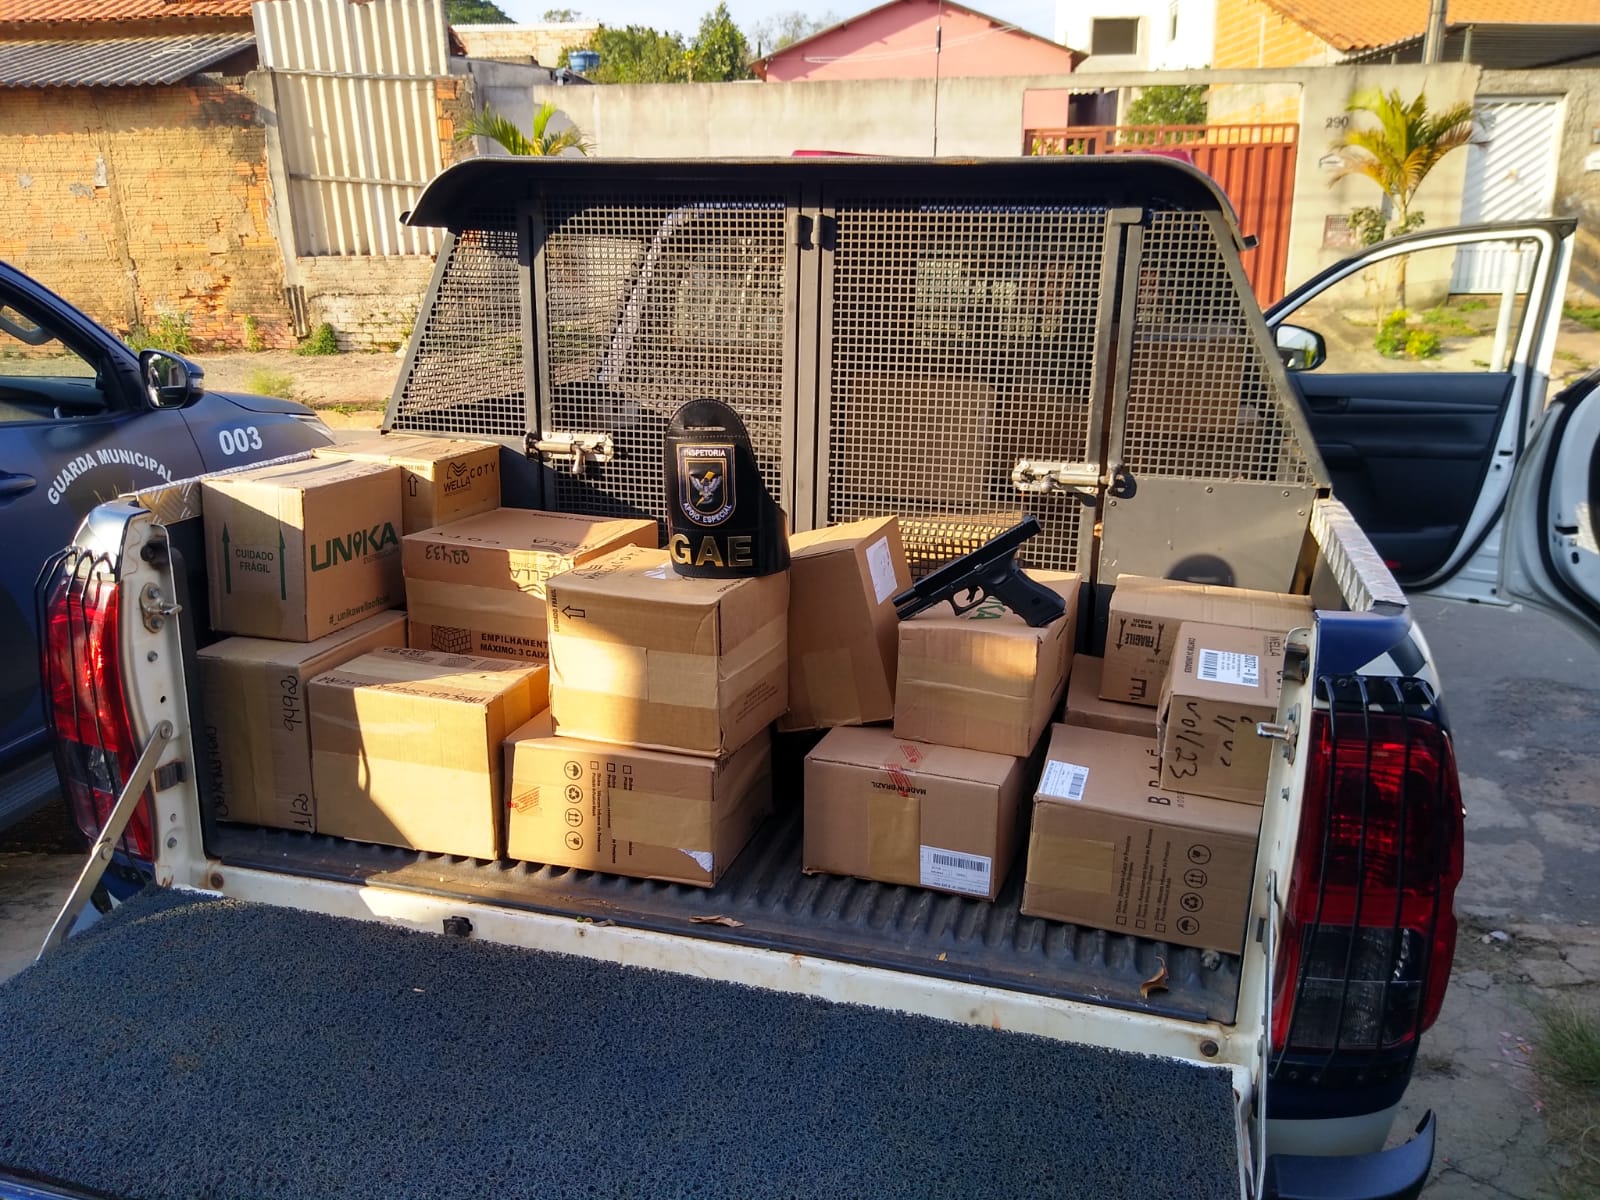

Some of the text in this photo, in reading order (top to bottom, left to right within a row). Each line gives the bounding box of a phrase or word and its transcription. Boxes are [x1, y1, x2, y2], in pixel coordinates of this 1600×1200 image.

[1325, 116, 1349, 129] 290
[218, 426, 263, 456] 003
[683, 449, 726, 458] INSPETORIA
[47, 448, 173, 505] GUARDA MUNICIPAL
[469, 461, 497, 479] COTY
[443, 477, 471, 493] WELLA
[683, 502, 733, 524] APOIO ESPECIAL
[235, 548, 274, 561] CUIDADO
[669, 533, 754, 568] GAE
[509, 568, 556, 582] ELLA
[481, 632, 549, 649] EMPILHAMENT
[1124, 632, 1155, 649] FRAGILE
[1268, 636, 1282, 657] WELLA
[518, 648, 524, 656] 3
[525, 649, 549, 660] CAIX
[871, 781, 896, 791] BRAZIL
[905, 786, 927, 796] MADE
